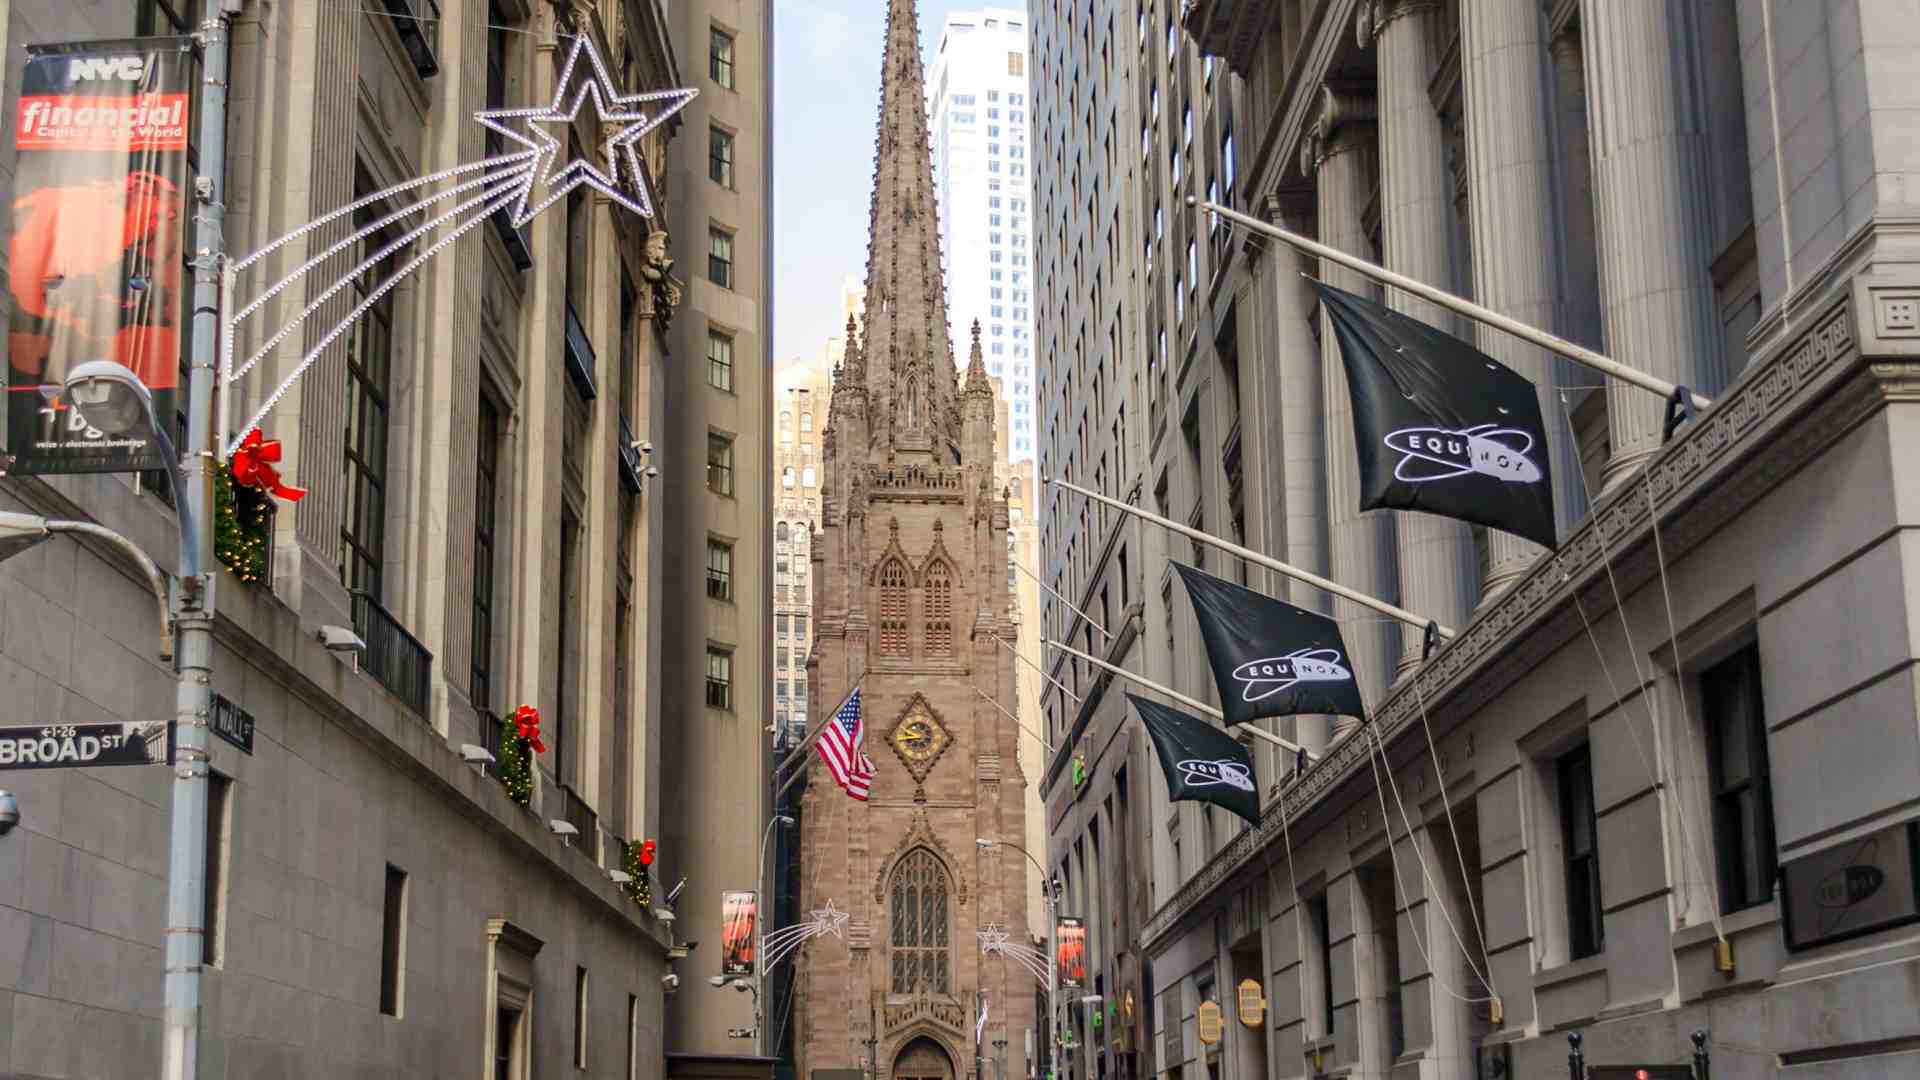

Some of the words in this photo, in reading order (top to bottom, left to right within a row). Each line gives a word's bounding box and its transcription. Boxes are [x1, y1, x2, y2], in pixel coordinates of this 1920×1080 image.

[69, 57, 144, 81] NYC
[24, 100, 183, 133] financial
[140, 126, 182, 137] World
[0, 736, 100, 764] BROAD
[101, 735, 122, 748] ST
